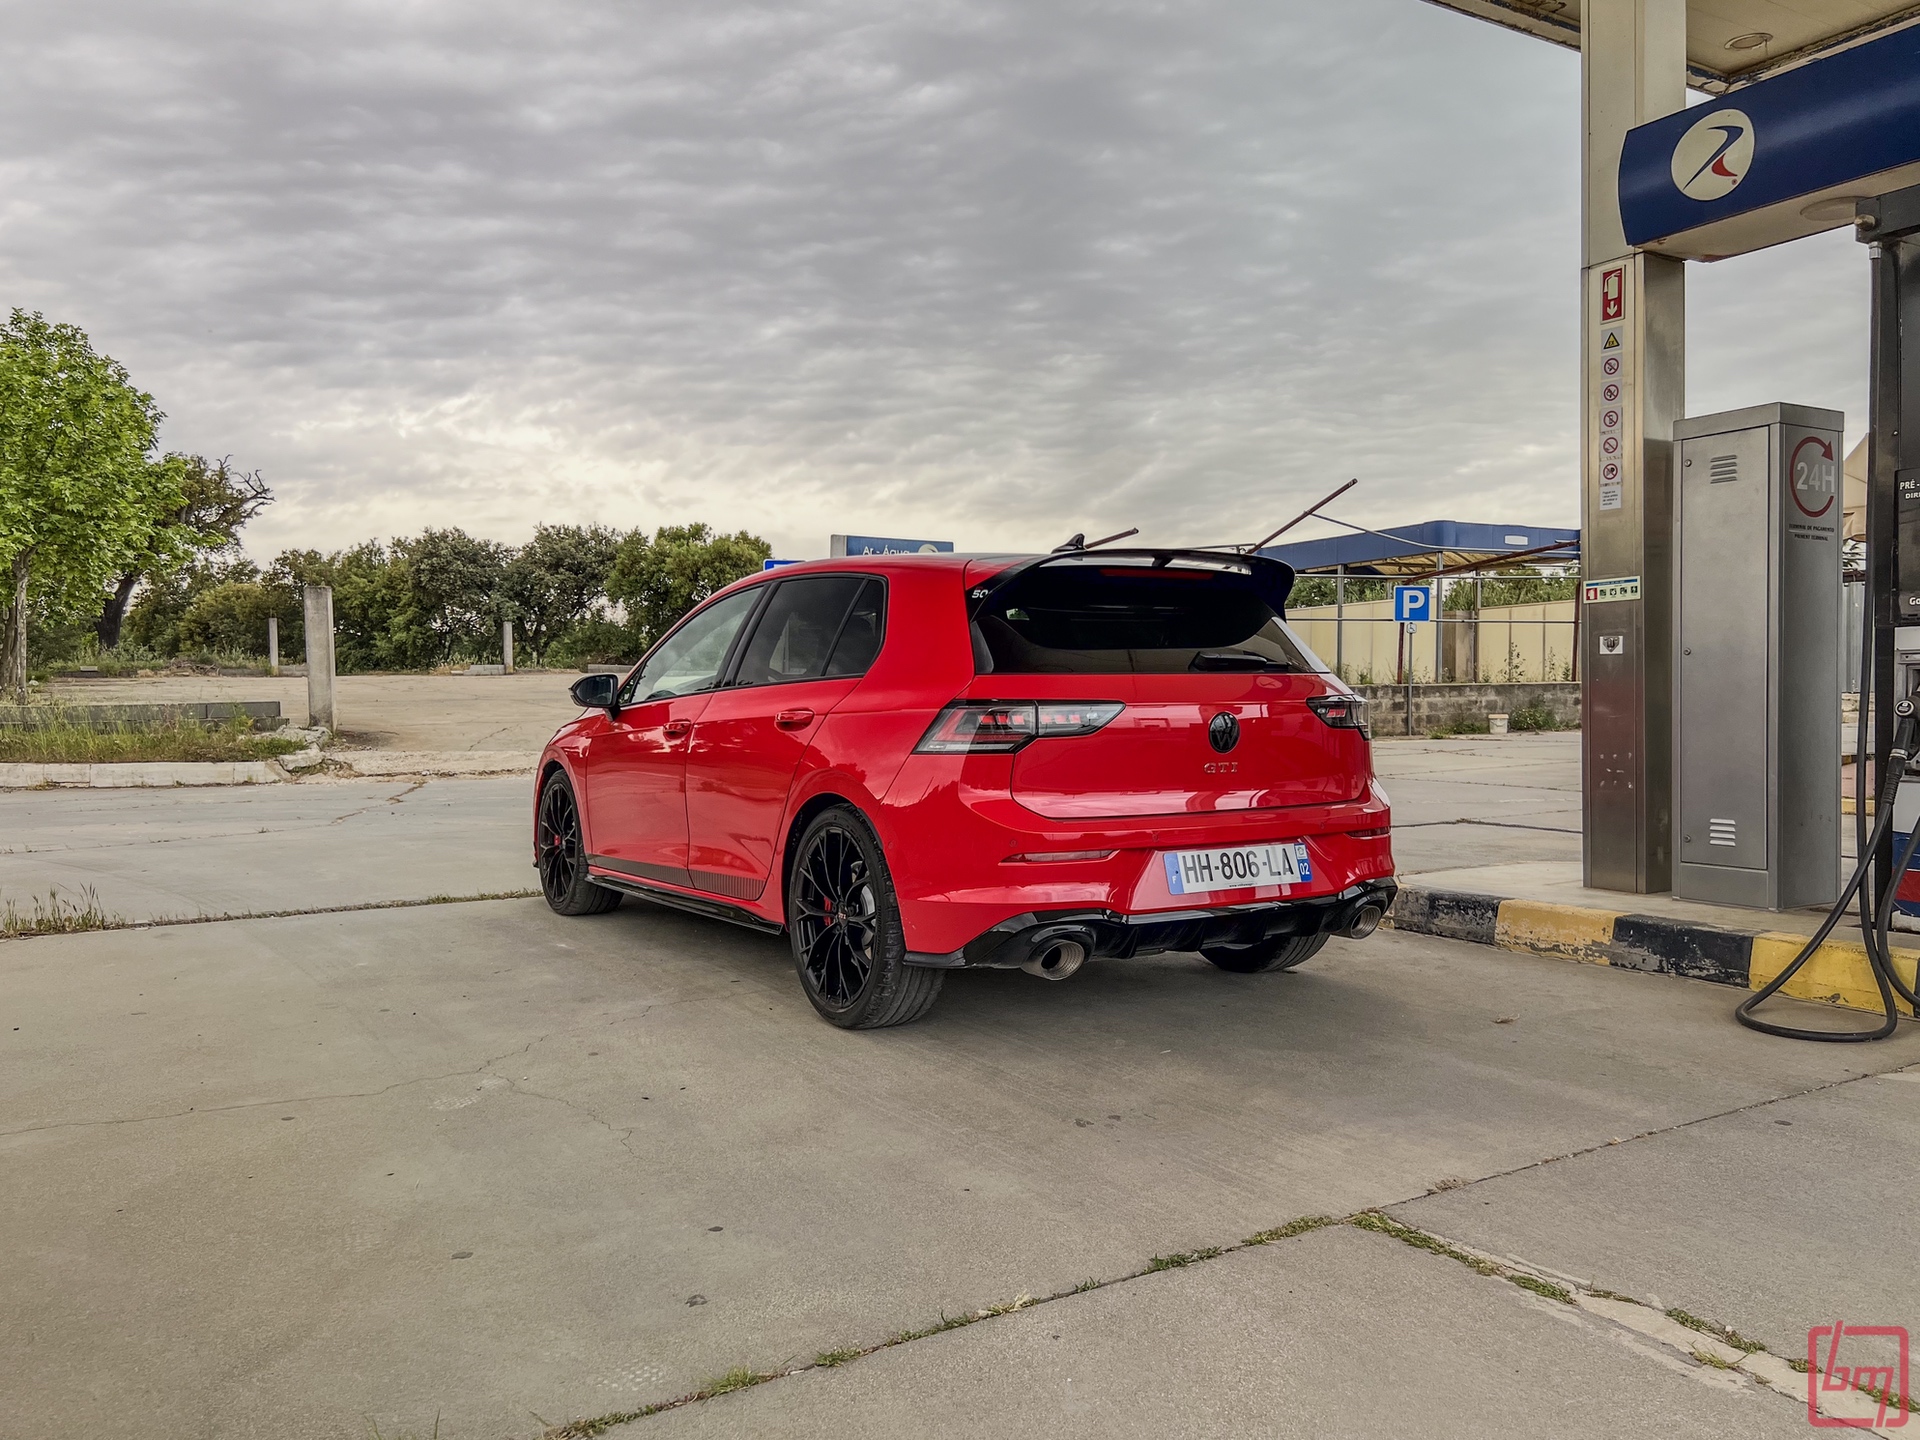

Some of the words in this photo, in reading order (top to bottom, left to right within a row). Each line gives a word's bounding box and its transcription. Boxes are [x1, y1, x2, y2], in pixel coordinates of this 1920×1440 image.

[1796, 461, 1835, 493] 24H
[1899, 479, 1915, 490] PRÉ
[1403, 590, 1425, 618] P
[1204, 762, 1238, 773] GTI
[1181, 847, 1295, 884] HH-806-LA
[1299, 862, 1310, 875] 02
